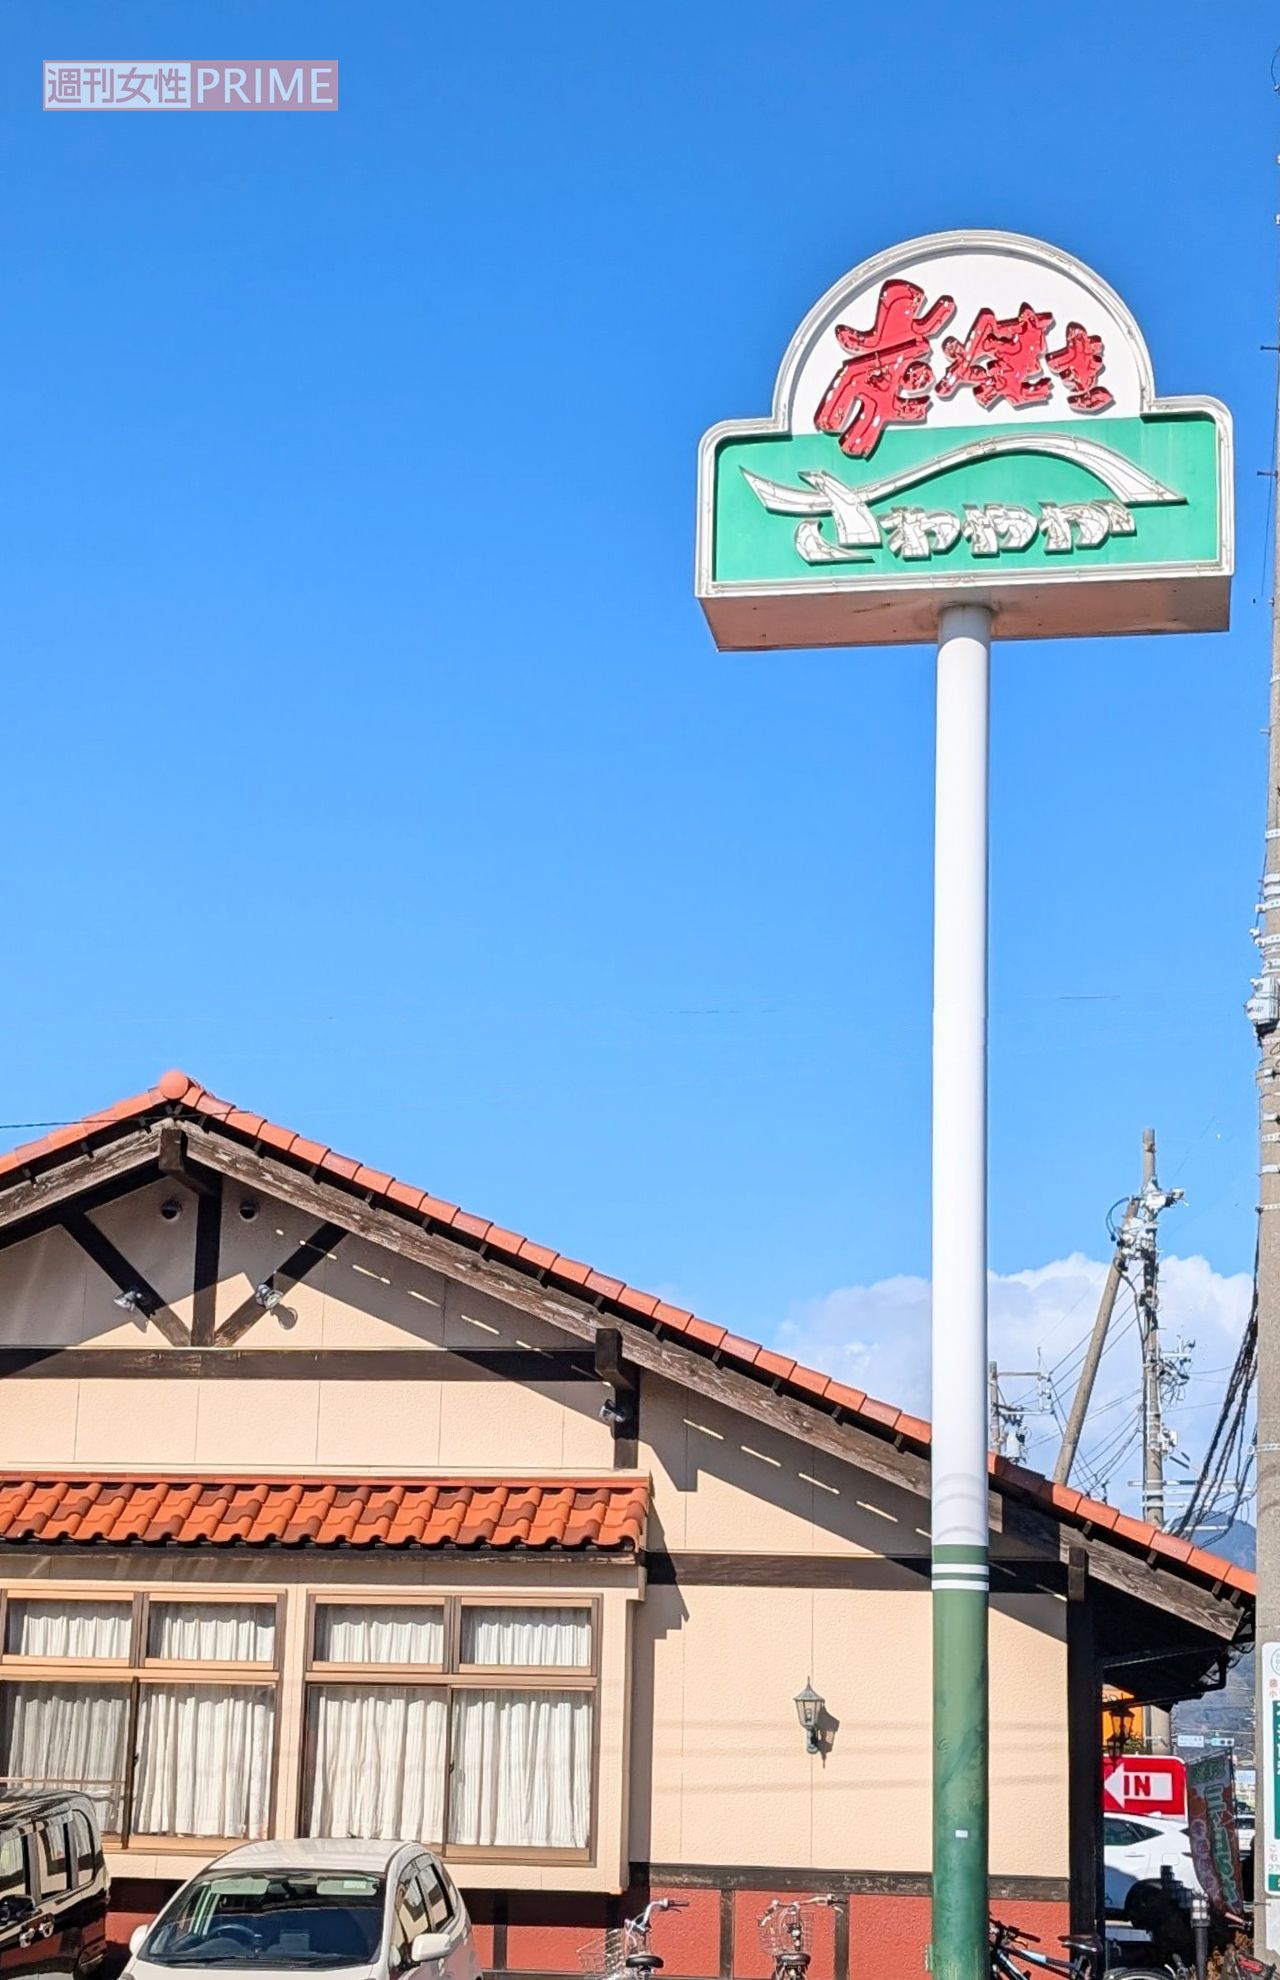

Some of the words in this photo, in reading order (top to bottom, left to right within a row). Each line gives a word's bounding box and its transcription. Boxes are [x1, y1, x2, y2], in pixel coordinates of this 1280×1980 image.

[739, 432, 1188, 566] さわやか
[1123, 1774, 1151, 1797] IN
